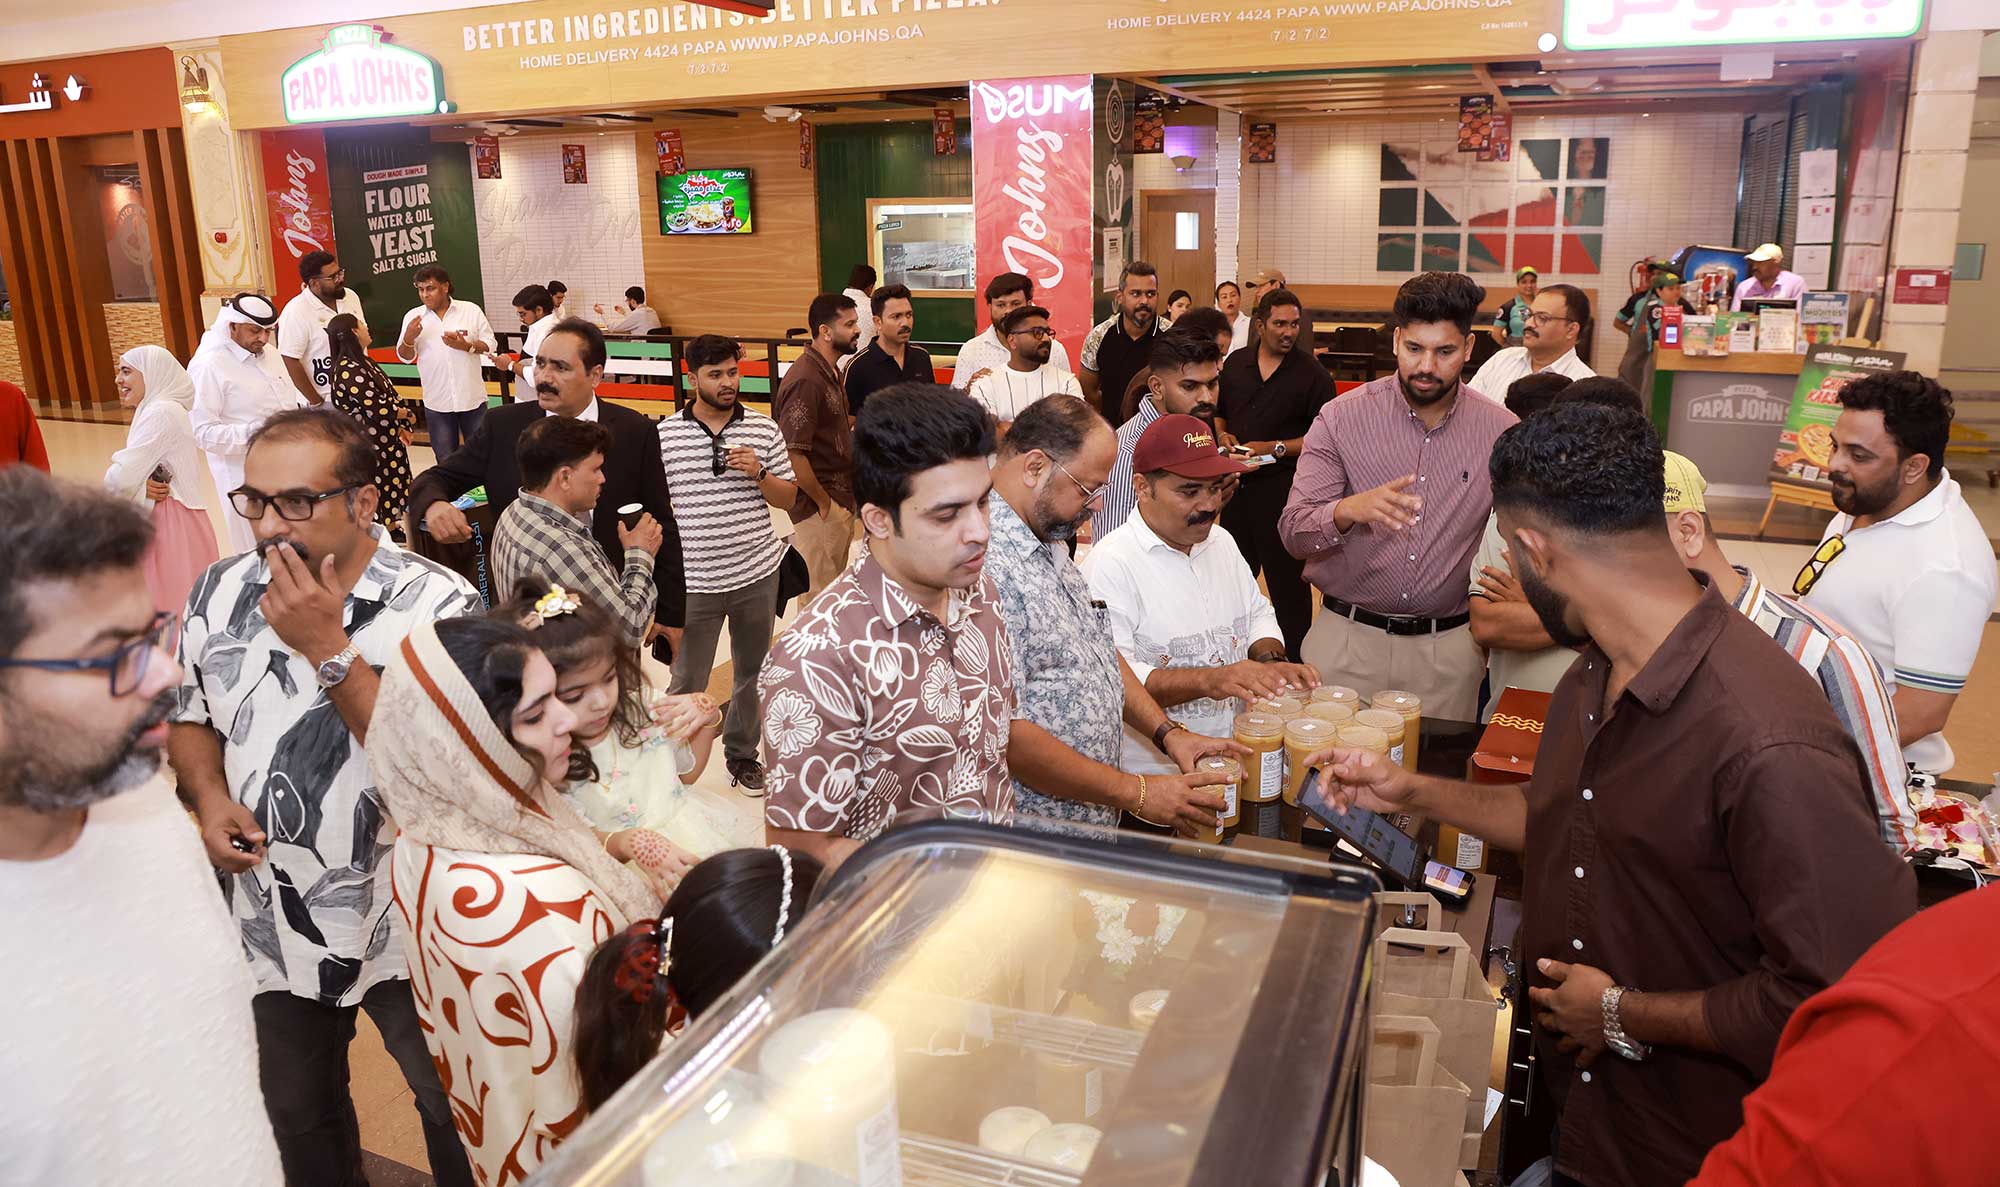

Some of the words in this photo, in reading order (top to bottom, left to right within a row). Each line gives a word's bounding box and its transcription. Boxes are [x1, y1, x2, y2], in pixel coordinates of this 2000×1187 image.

[1107, 16, 1152, 30] HOME
[1156, 12, 1232, 27] DELIVERY
[1237, 9, 1272, 22] 4424
[1276, 6, 1320, 20] PAPA
[1325, 0, 1513, 17] WWW.PAPAJOHNS.QA
[463, 18, 555, 51] BETTER
[520, 53, 562, 69] HOME
[567, 47, 640, 66] DELIVERY
[644, 44, 678, 59] 4424
[684, 38, 727, 56] PAPA
[731, 23, 924, 52] WWW.PAPAJOHNS.QA
[288, 62, 345, 112] PAPA
[350, 57, 430, 107] JOHN'S
[366, 172, 387, 182] DOUGH
[387, 170, 403, 180] MADE
[404, 166, 425, 177] SIMPLE
[279, 148, 324, 259] Johns
[364, 182, 432, 214] FLOUR
[1001, 119, 1064, 290] Johns
[367, 214, 404, 232] WATER
[405, 212, 414, 225] &
[415, 208, 433, 223] OIL
[368, 223, 435, 259] YEAST
[372, 259, 395, 276] SALT
[396, 256, 405, 270] &
[406, 250, 438, 267] SUGAR
[1692, 399, 1734, 419] PAPA
